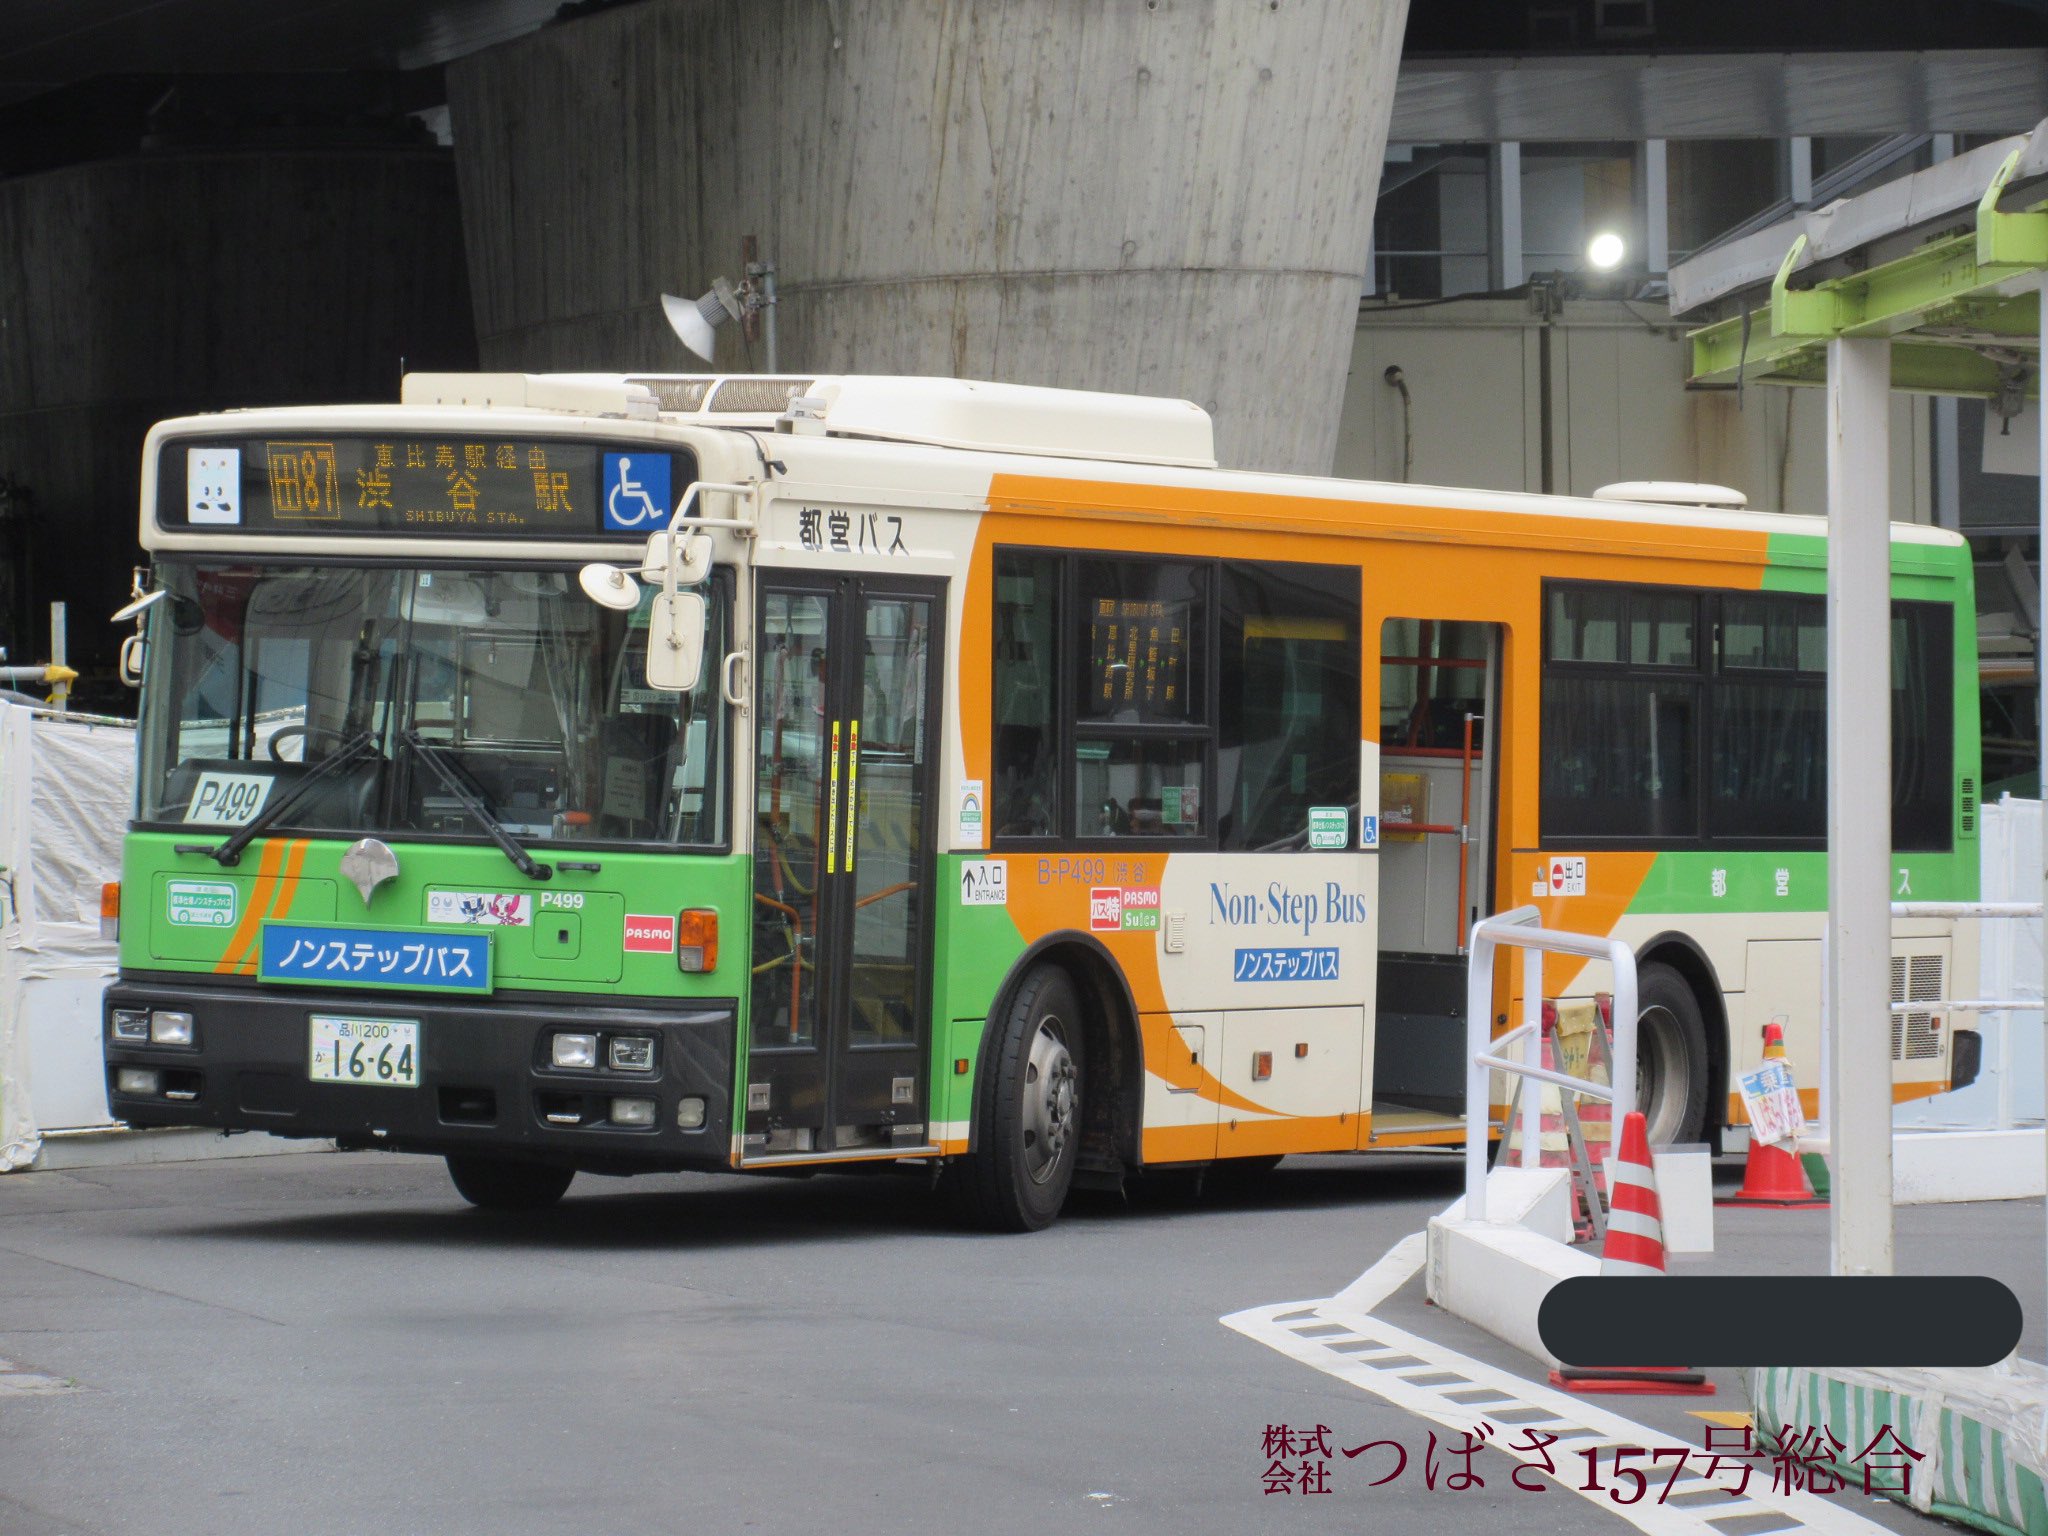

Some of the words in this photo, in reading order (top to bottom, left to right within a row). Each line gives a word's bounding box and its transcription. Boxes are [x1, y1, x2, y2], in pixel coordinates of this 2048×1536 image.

[374, 444, 547, 470] 恵比寿駅経由
[356, 467, 573, 511] 渋谷駅
[406, 510, 477, 523] SHIBUYA
[486, 511, 525, 524] STA.
[799, 507, 909, 556] 都営バス
[193, 780, 260, 822] P499
[979, 866, 1001, 885] 入口
[1038, 858, 1105, 884] B-P499
[1566, 861, 1583, 879] 出口
[975, 889, 1005, 901] ENTRANCE
[1124, 891, 1157, 905] PASMO
[1568, 883, 1581, 893] EXIT
[541, 892, 584, 909] P499
[1092, 896, 1119, 922] バス特
[1324, 882, 1366, 924] Bus
[1125, 912, 1156, 927] Suica
[626, 928, 671, 940] PASMO
[279, 940, 472, 977] ノンステップバス
[1236, 951, 1338, 979] ノンステップバス
